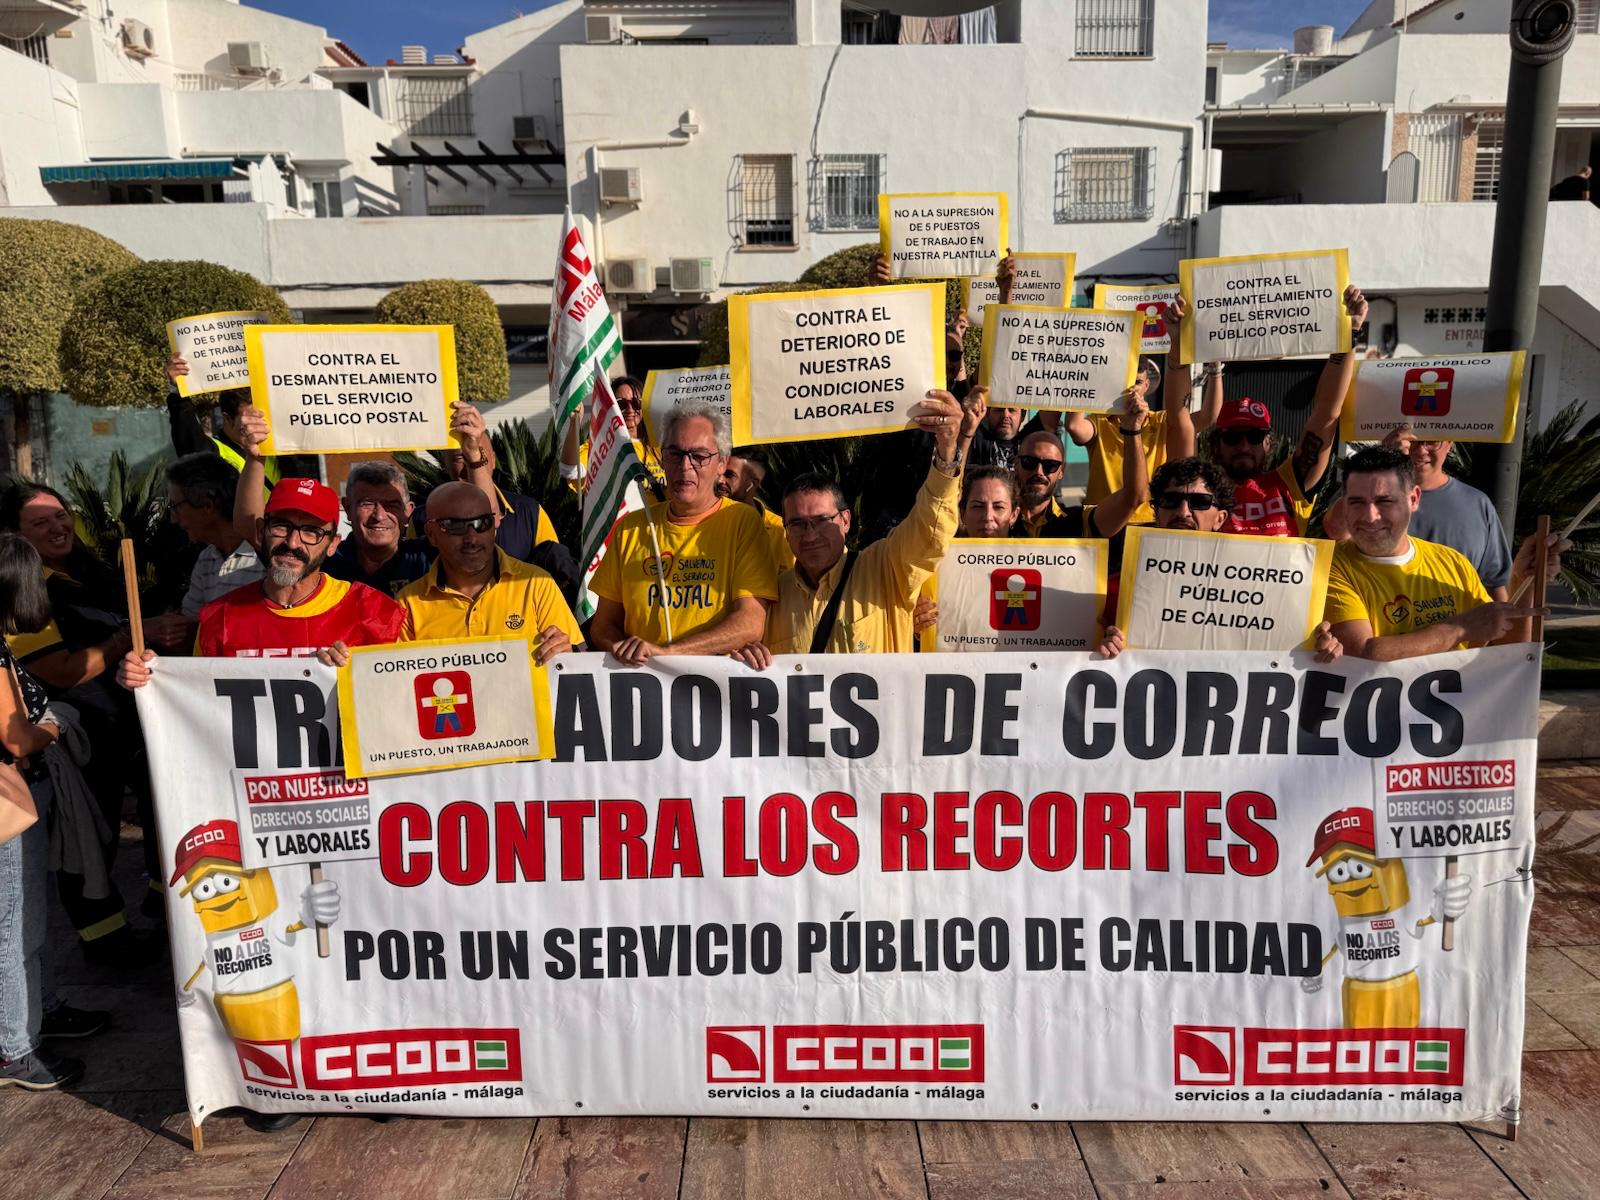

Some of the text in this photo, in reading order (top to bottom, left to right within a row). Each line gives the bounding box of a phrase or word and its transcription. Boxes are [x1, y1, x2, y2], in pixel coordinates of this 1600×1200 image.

[894, 206, 994, 218] NO A LA SUPRESIÓN
[910, 222, 980, 232] DE 5 PUESTOS
[906, 236, 984, 246] DE TRABAJO EN
[893, 250, 996, 260] NUESTRA PLANTILLA
[1227, 276, 1301, 290] CONTRA EL
[1198, 288, 1332, 310] DESMANTELAMIENTO
[796, 306, 891, 328] CONTRA EL
[1220, 306, 1310, 324] DEL SERVICIO
[177, 326, 190, 336] NO
[202, 323, 215, 332] LA
[1002, 317, 1125, 333] NO A LA SUPRESIÓN
[1210, 322, 1322, 341] PÚBLICO POSTAL
[194, 337, 208, 346] DE
[218, 332, 244, 341] PUES
[782, 330, 906, 352] DETERIORO DE
[1018, 334, 1105, 348] DE 5 PUESTOS
[193, 345, 246, 358] DE TRABAJ
[308, 354, 400, 366] CONTRA EL
[1011, 350, 1108, 366] DE TRABAJO EN
[800, 356, 891, 376] NUESTRAS
[1026, 368, 1089, 382] ALHAURÍN
[206, 374, 220, 382] DE
[222, 371, 234, 380] LA
[272, 372, 437, 386] DESMANTELAMIENTO
[678, 374, 717, 383] CONTRA
[668, 384, 722, 394] DETERIORO
[785, 378, 904, 399] CONDICIONES
[1016, 385, 1096, 399] DE LA TORRE
[302, 392, 413, 406] DEL SERVICIO
[290, 410, 428, 426] PÚBLICO POSTAL
[794, 400, 894, 420] LABORALES
[1430, 422, 1494, 431] TRABAJADOR
[678, 559, 715, 570] SALVEMOS
[957, 552, 1076, 566] CORREO PÚBLICO
[672, 572, 715, 582] EL SERVICIO
[1145, 558, 1304, 585] POR UN CORREO
[648, 584, 713, 609] POSTAL
[1180, 584, 1264, 606] PÚBLICO
[1162, 608, 1274, 631] DE CALIDAD
[960, 636, 1000, 646] PUESTO,
[1004, 637, 1018, 645] UN
[1020, 638, 1086, 648] TRABAJADOR
[374, 652, 507, 674] CORREO PÚBLICO
[215, 668, 1464, 768] TRADORES DE CORREOS
[370, 738, 529, 762] UN PUESTO, UN TRABAJADOR
[1389, 764, 1513, 789] POR NUESTROS
[248, 776, 367, 800] POR NUESTROS
[1388, 796, 1512, 816] DERECHOS SOCIALES
[252, 805, 368, 828] DERECHOS SOCIALES
[1324, 816, 1360, 834] CCOO
[186, 828, 224, 852] CCOO
[256, 828, 370, 858] Y LABORALES
[378, 790, 1278, 888] CONTRA LOS RECORTES
[1390, 820, 1511, 848] Y LABORALES
[1372, 920, 1394, 930] CCOO
[241, 929, 263, 940] CCOO
[1346, 930, 1400, 948] NO A LOS
[214, 939, 270, 962] NO A LOS
[344, 911, 1322, 981] POR UN SERVICIO PÚBLICO DE CALIDAD
[1348, 946, 1400, 960] RECORTES
[217, 954, 272, 976] RECORTES
[315, 1040, 470, 1080] CCOO
[786, 1038, 934, 1070] CCOO
[1257, 1040, 1410, 1073] CCOO
[246, 1085, 524, 1103] servicios a la ciudadanía málaga
[708, 1086, 984, 1101] servicios a la ciudadanía málaga
[1175, 1088, 1462, 1104] servicios a la ciudadanía málaga
